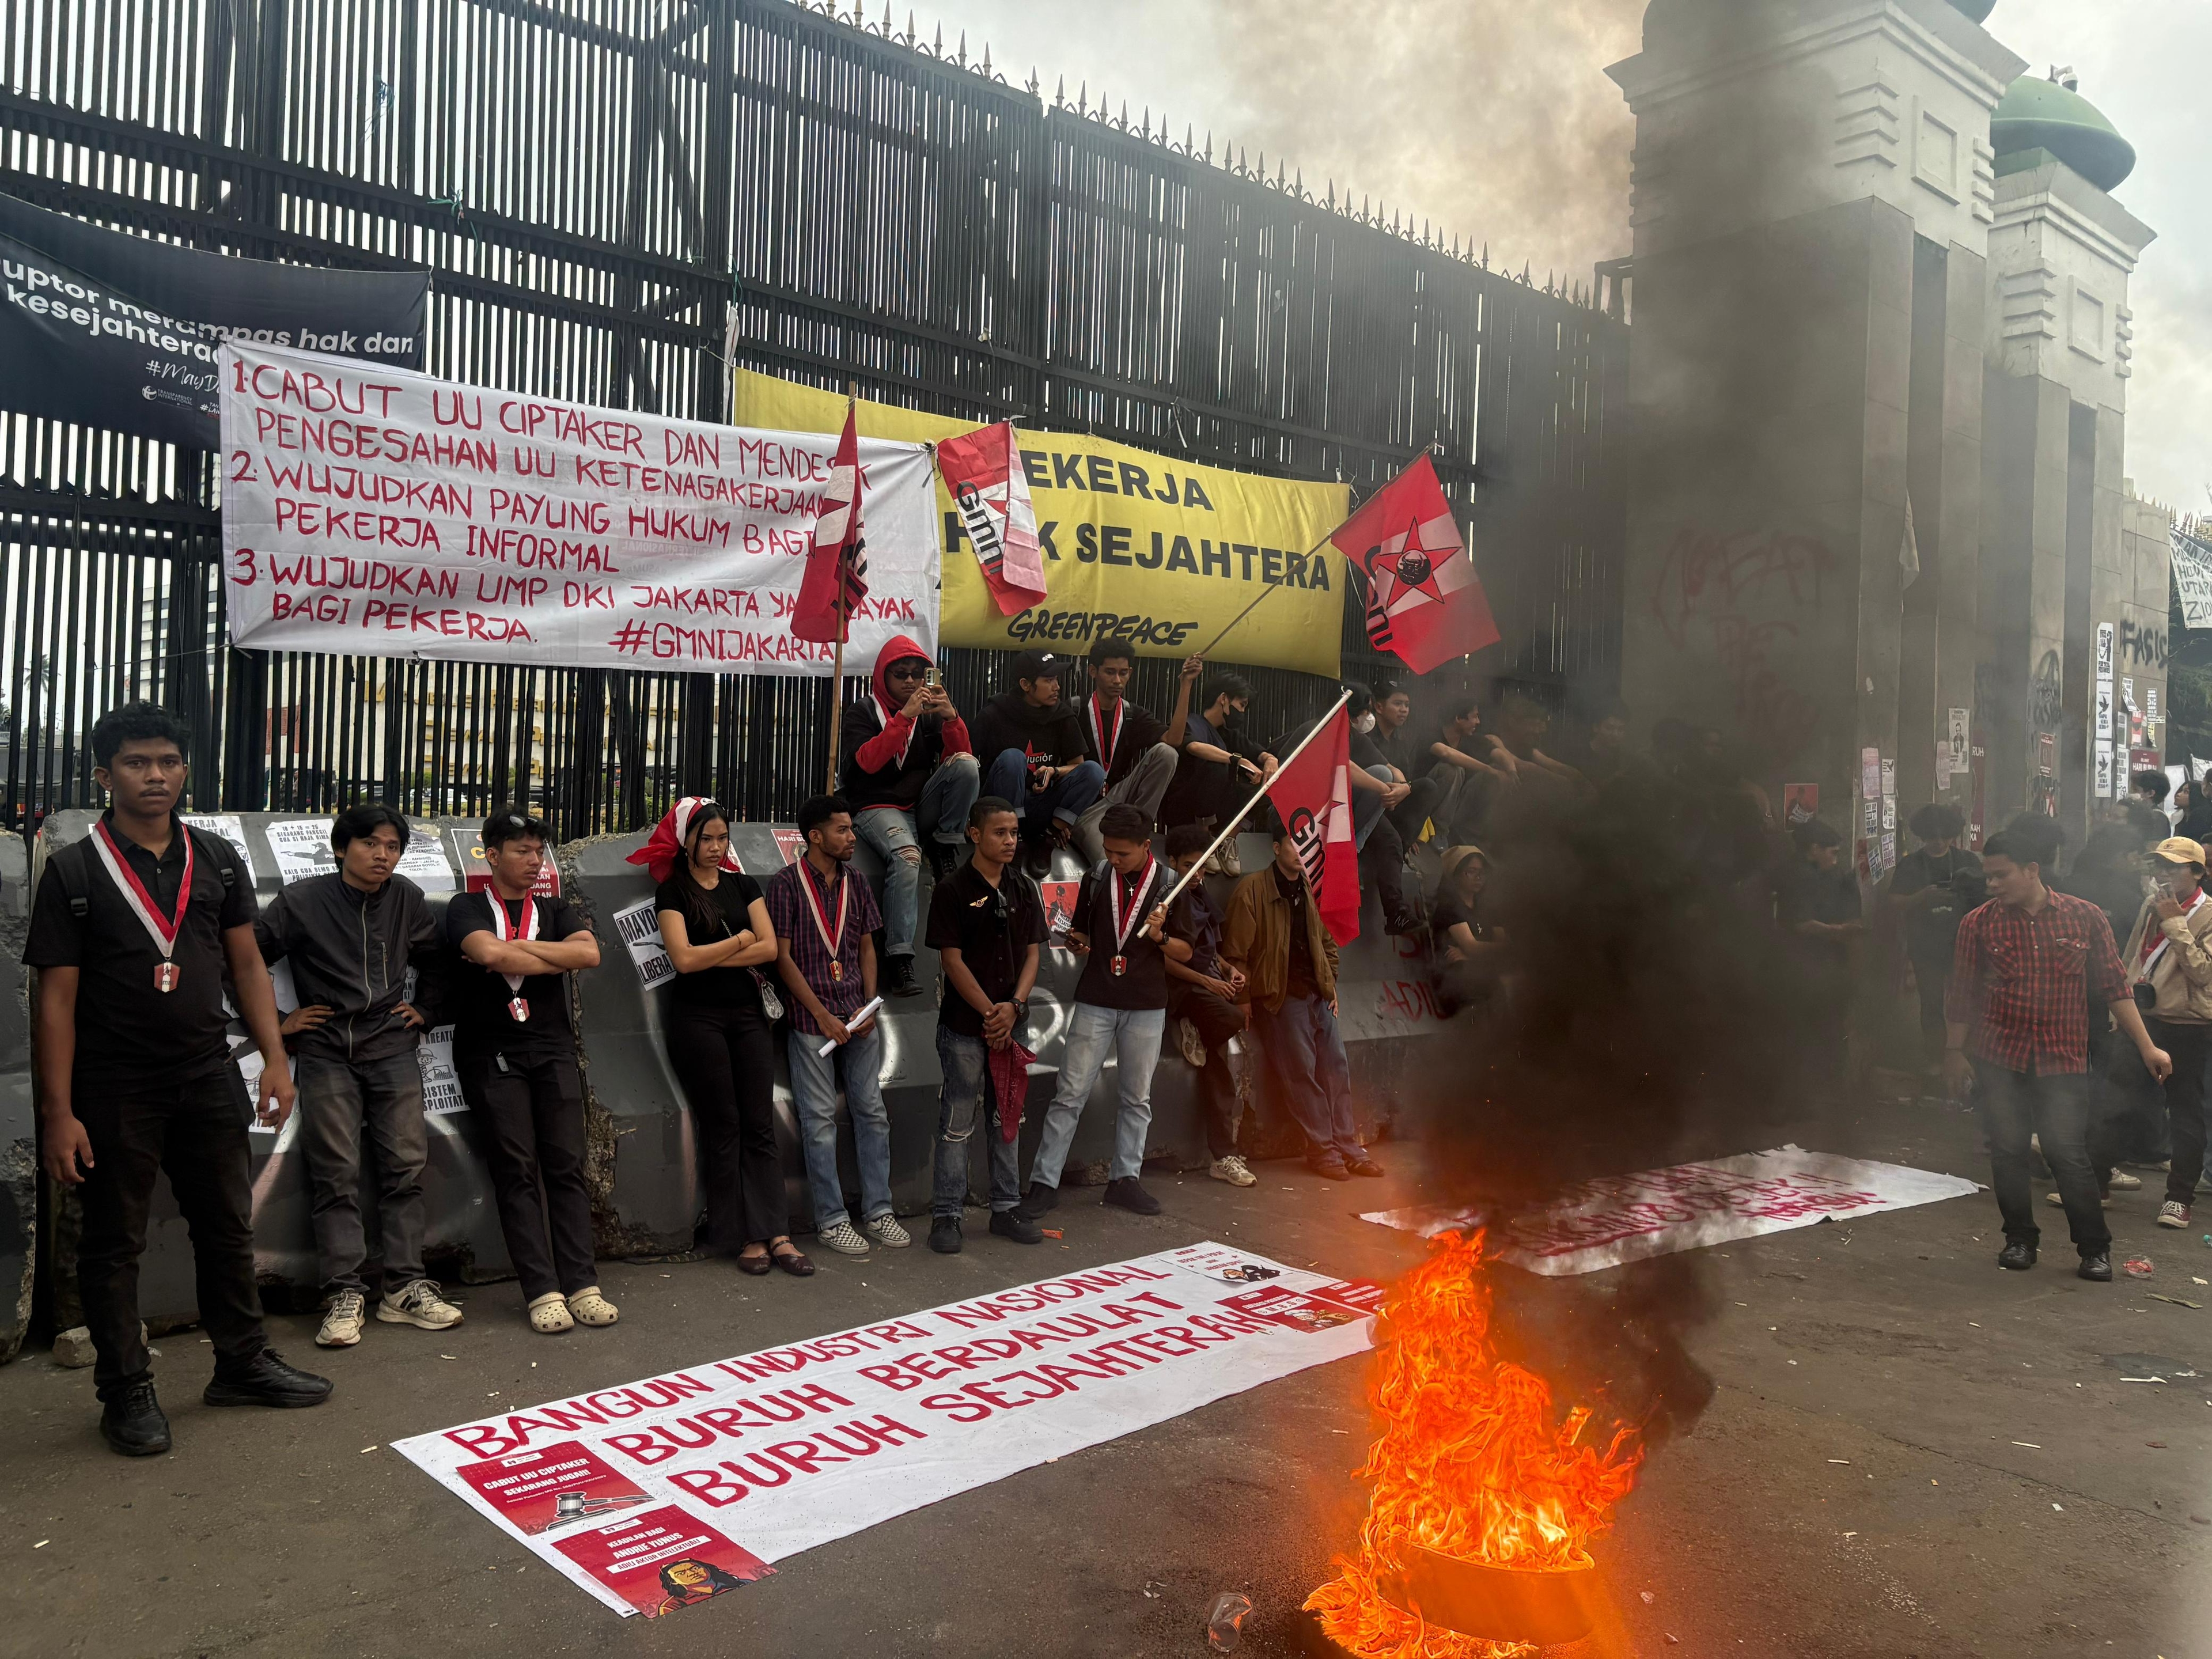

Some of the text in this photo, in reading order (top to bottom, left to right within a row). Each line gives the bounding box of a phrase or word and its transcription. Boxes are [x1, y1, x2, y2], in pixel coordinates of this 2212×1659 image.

[0, 259, 414, 354] uptor merampas hak dan
[145, 359, 219, 394] #MayD
[158, 389, 192, 402] TRANSPARENCY
[251, 364, 403, 419] CABUT
[433, 389, 483, 431] UU
[499, 400, 647, 463] CIPTAKER
[665, 428, 720, 470] DAN
[738, 435, 872, 491] MENDEK
[255, 408, 498, 475] PENGESAHAN
[515, 446, 555, 479] UU
[264, 455, 473, 519] WUJUDKAN
[491, 488, 610, 535] PAYUNG
[629, 503, 730, 548] HUKUM
[743, 522, 815, 558] BAGI
[1019, 450, 1214, 511] EKERJA
[276, 498, 620, 573] PEKERJA INFORMAL
[1077, 522, 1330, 592] SEJAHTERA
[270, 554, 460, 600] WUJUDKAN
[477, 576, 548, 607] UMP
[564, 581, 615, 609] DKI
[631, 585, 760, 619] JAKARTA
[769, 591, 797, 618] YA
[2184, 601, 2212, 621] ZIO
[272, 591, 539, 644] BAGI PEKERJA.
[1008, 608, 1199, 646] GREENPEACE
[618, 906, 659, 944] MAYD
[441, 1264, 1174, 1459] BANGUN INDUSTRI NASIONAL
[601, 1291, 1185, 1465] BURUH BERDAULAT
[483, 1475, 522, 1490] CABUT
[520, 1471, 539, 1481] UU
[537, 1458, 590, 1477] CIPTAKER
[503, 1479, 557, 1497] SEKARANG
[666, 1414, 929, 1508] BURUH
[607, 1533, 646, 1548] KEADILAN
[645, 1527, 666, 1537] BAGI
[612, 1532, 684, 1559] ANDRIE YUNUS
[637, 1555, 657, 1565] AKTOR
